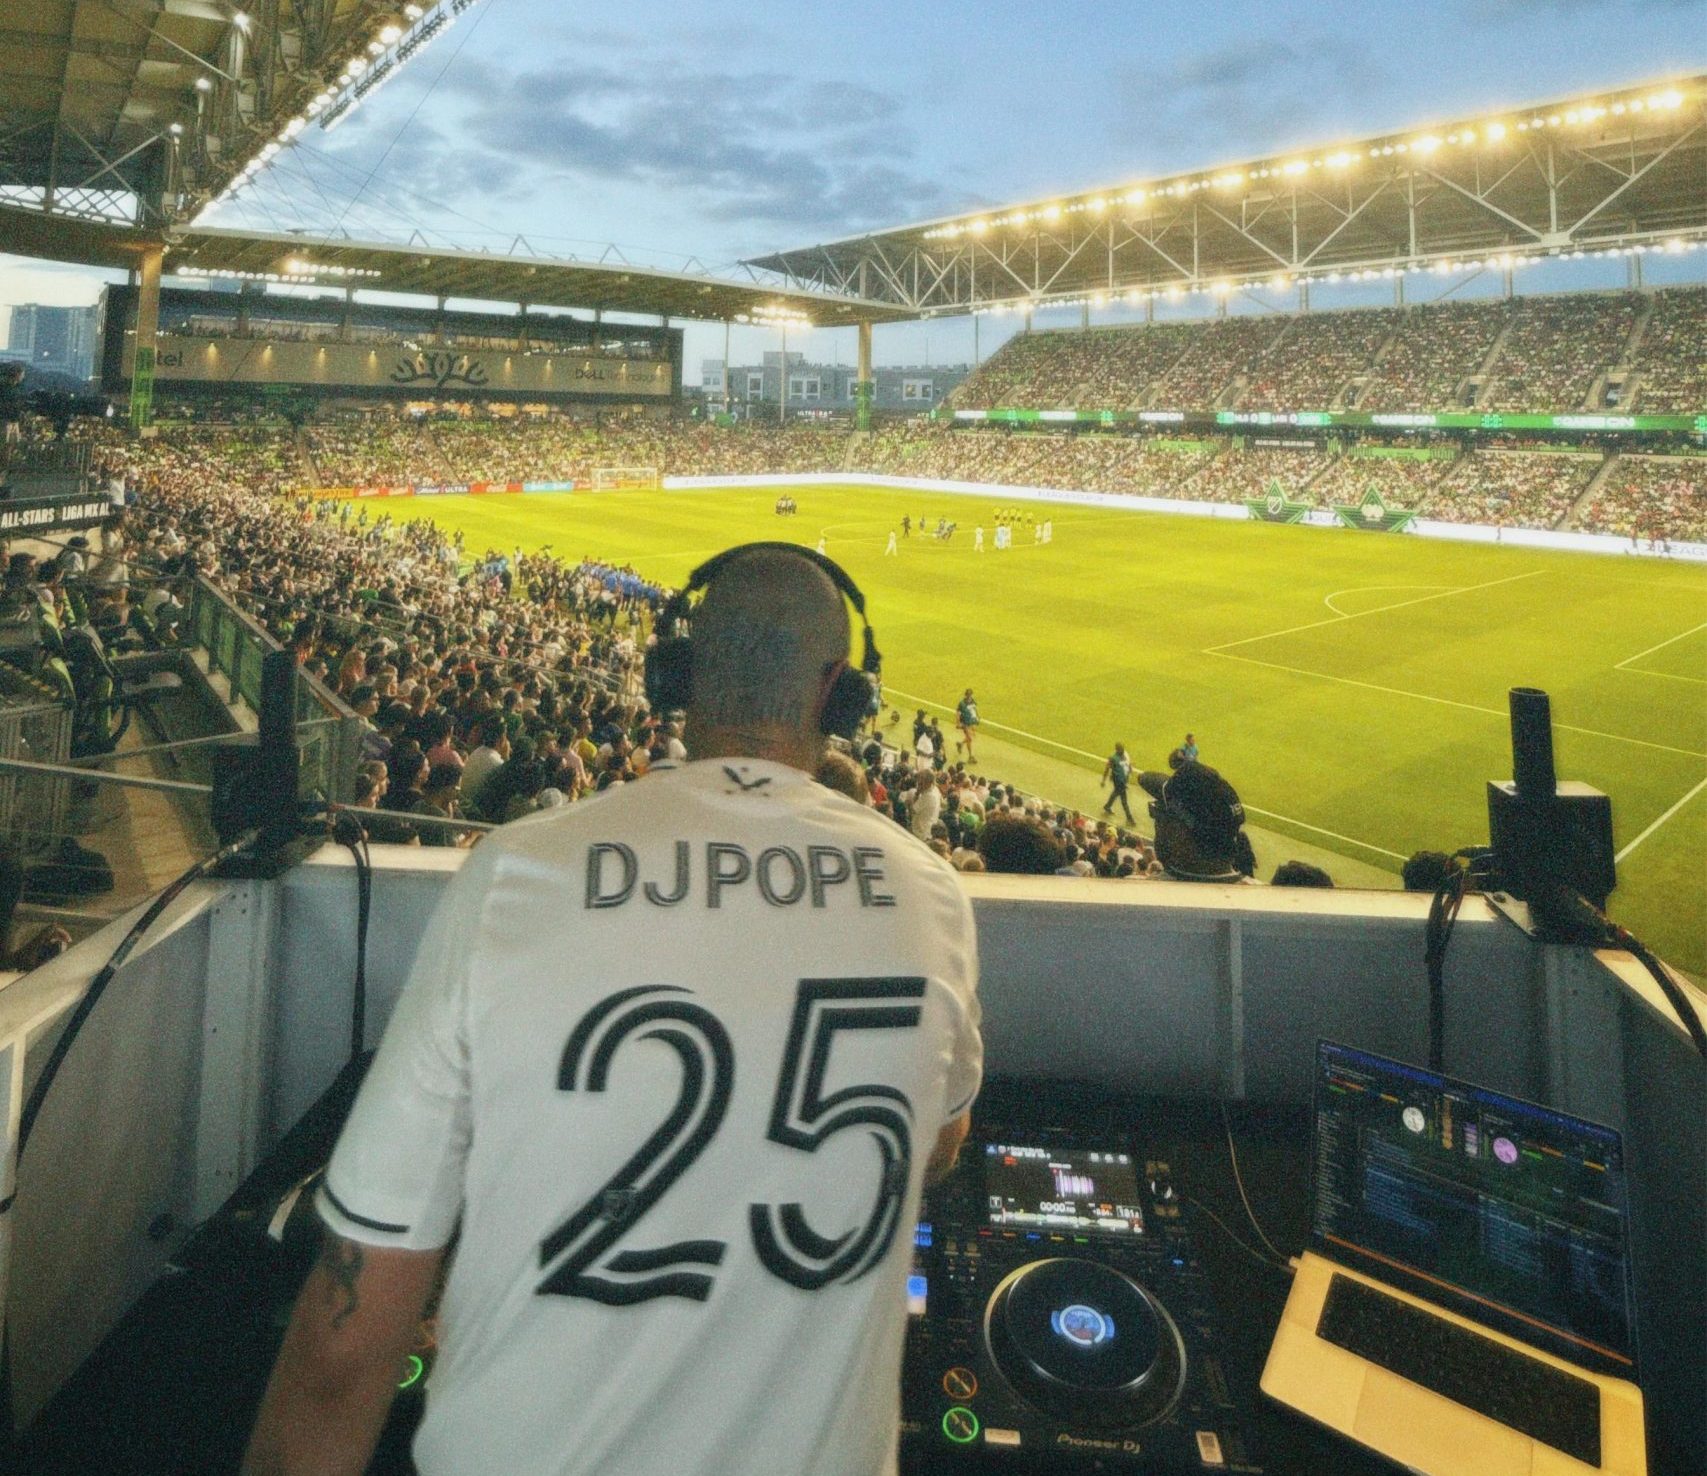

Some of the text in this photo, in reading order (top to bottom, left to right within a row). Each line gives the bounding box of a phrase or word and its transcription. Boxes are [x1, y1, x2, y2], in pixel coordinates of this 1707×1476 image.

[1, 508, 55, 528] ALL-STARS
[62, 504, 83, 521] LIGA
[84, 502, 99, 519] MX
[535, 976, 928, 1306] 25
[1056, 1433, 1121, 1449] Pioneer
